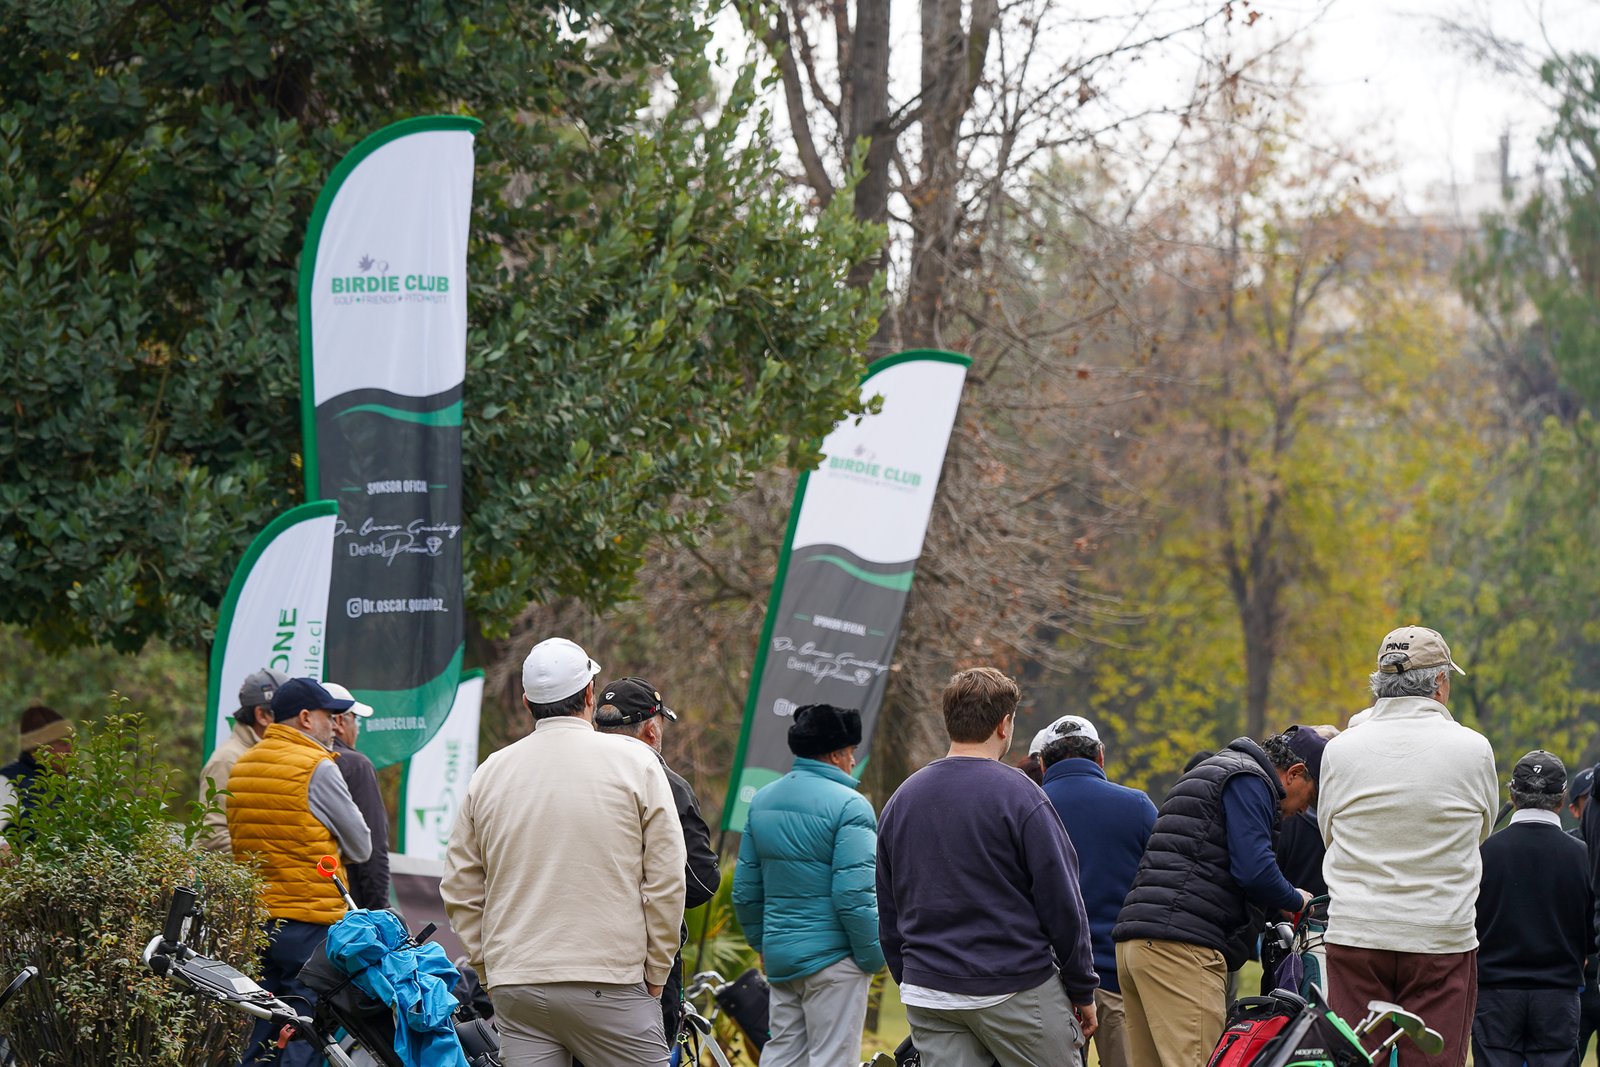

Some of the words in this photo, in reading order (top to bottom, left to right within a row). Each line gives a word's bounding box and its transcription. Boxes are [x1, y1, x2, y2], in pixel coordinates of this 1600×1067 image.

[331, 276, 400, 294] BIRDIE
[404, 274, 449, 292] CLUB
[829, 456, 880, 478] BIRDIE
[884, 467, 922, 487] CLUB
[1386, 642, 1410, 651] PING
